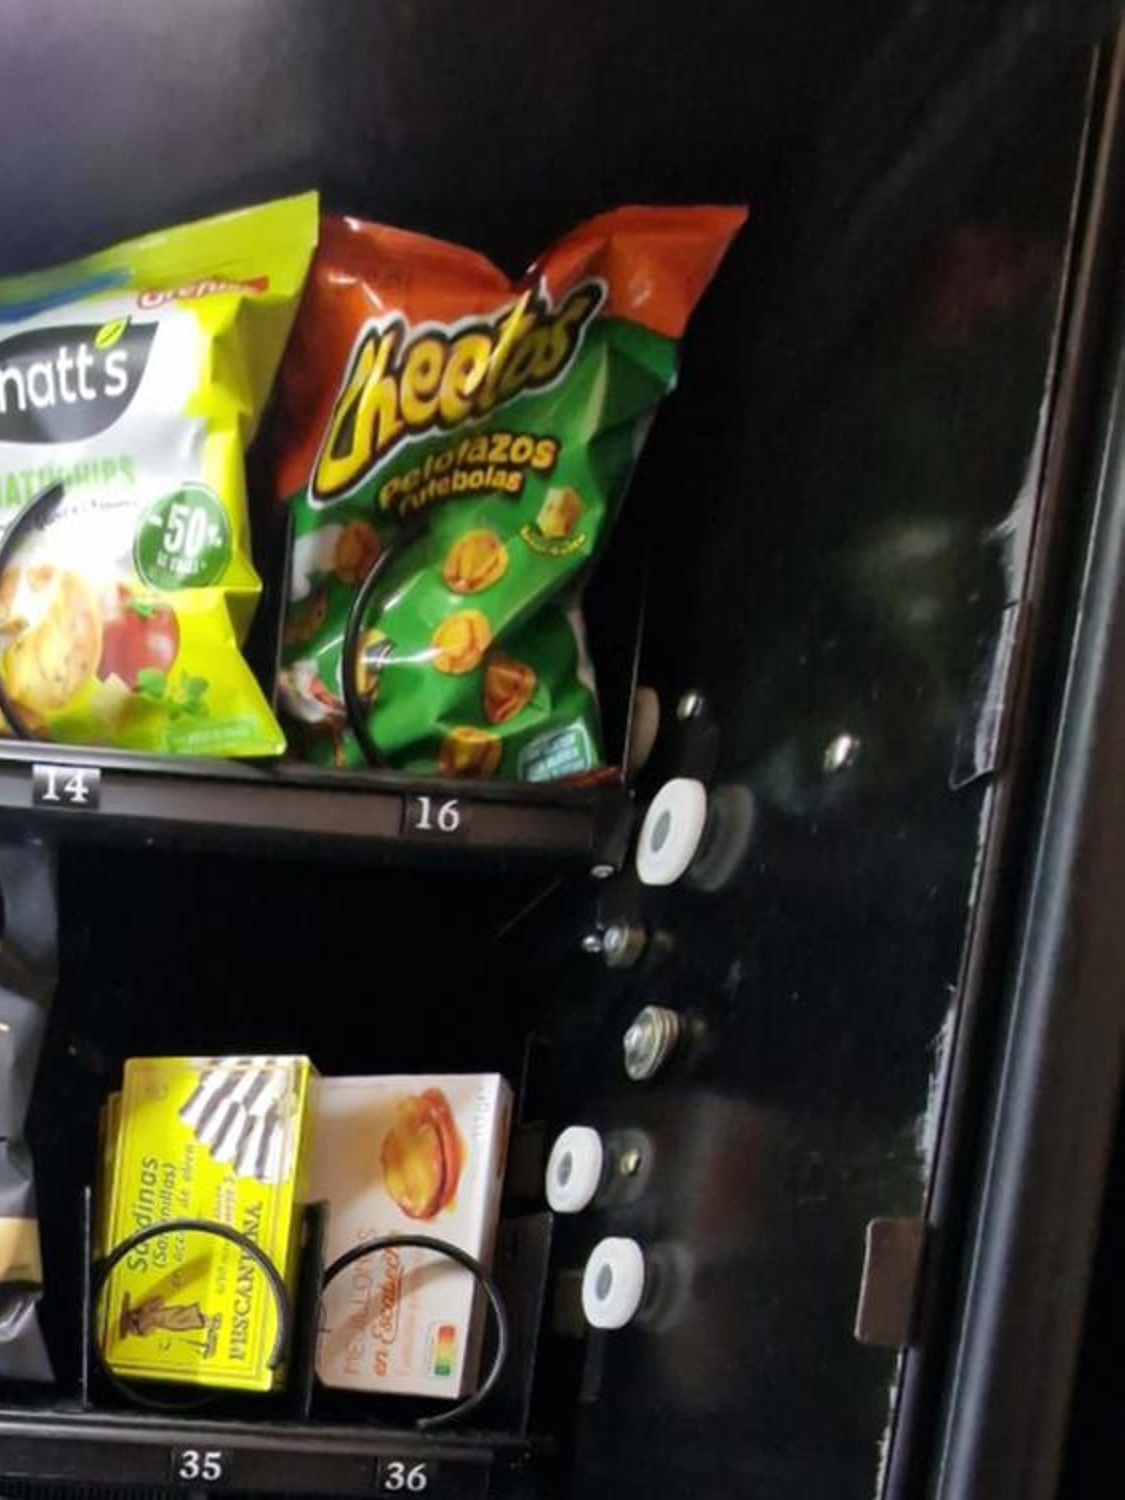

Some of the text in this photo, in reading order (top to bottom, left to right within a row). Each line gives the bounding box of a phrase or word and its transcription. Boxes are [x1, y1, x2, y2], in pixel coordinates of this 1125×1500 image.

[312, 281, 604, 500] Cheetos
[41, 770, 90, 802] 14
[414, 796, 461, 832] 16
[126, 1156, 160, 1275] Sadinas
[179, 1450, 223, 1481] 35
[384, 1462, 428, 1493] 36
